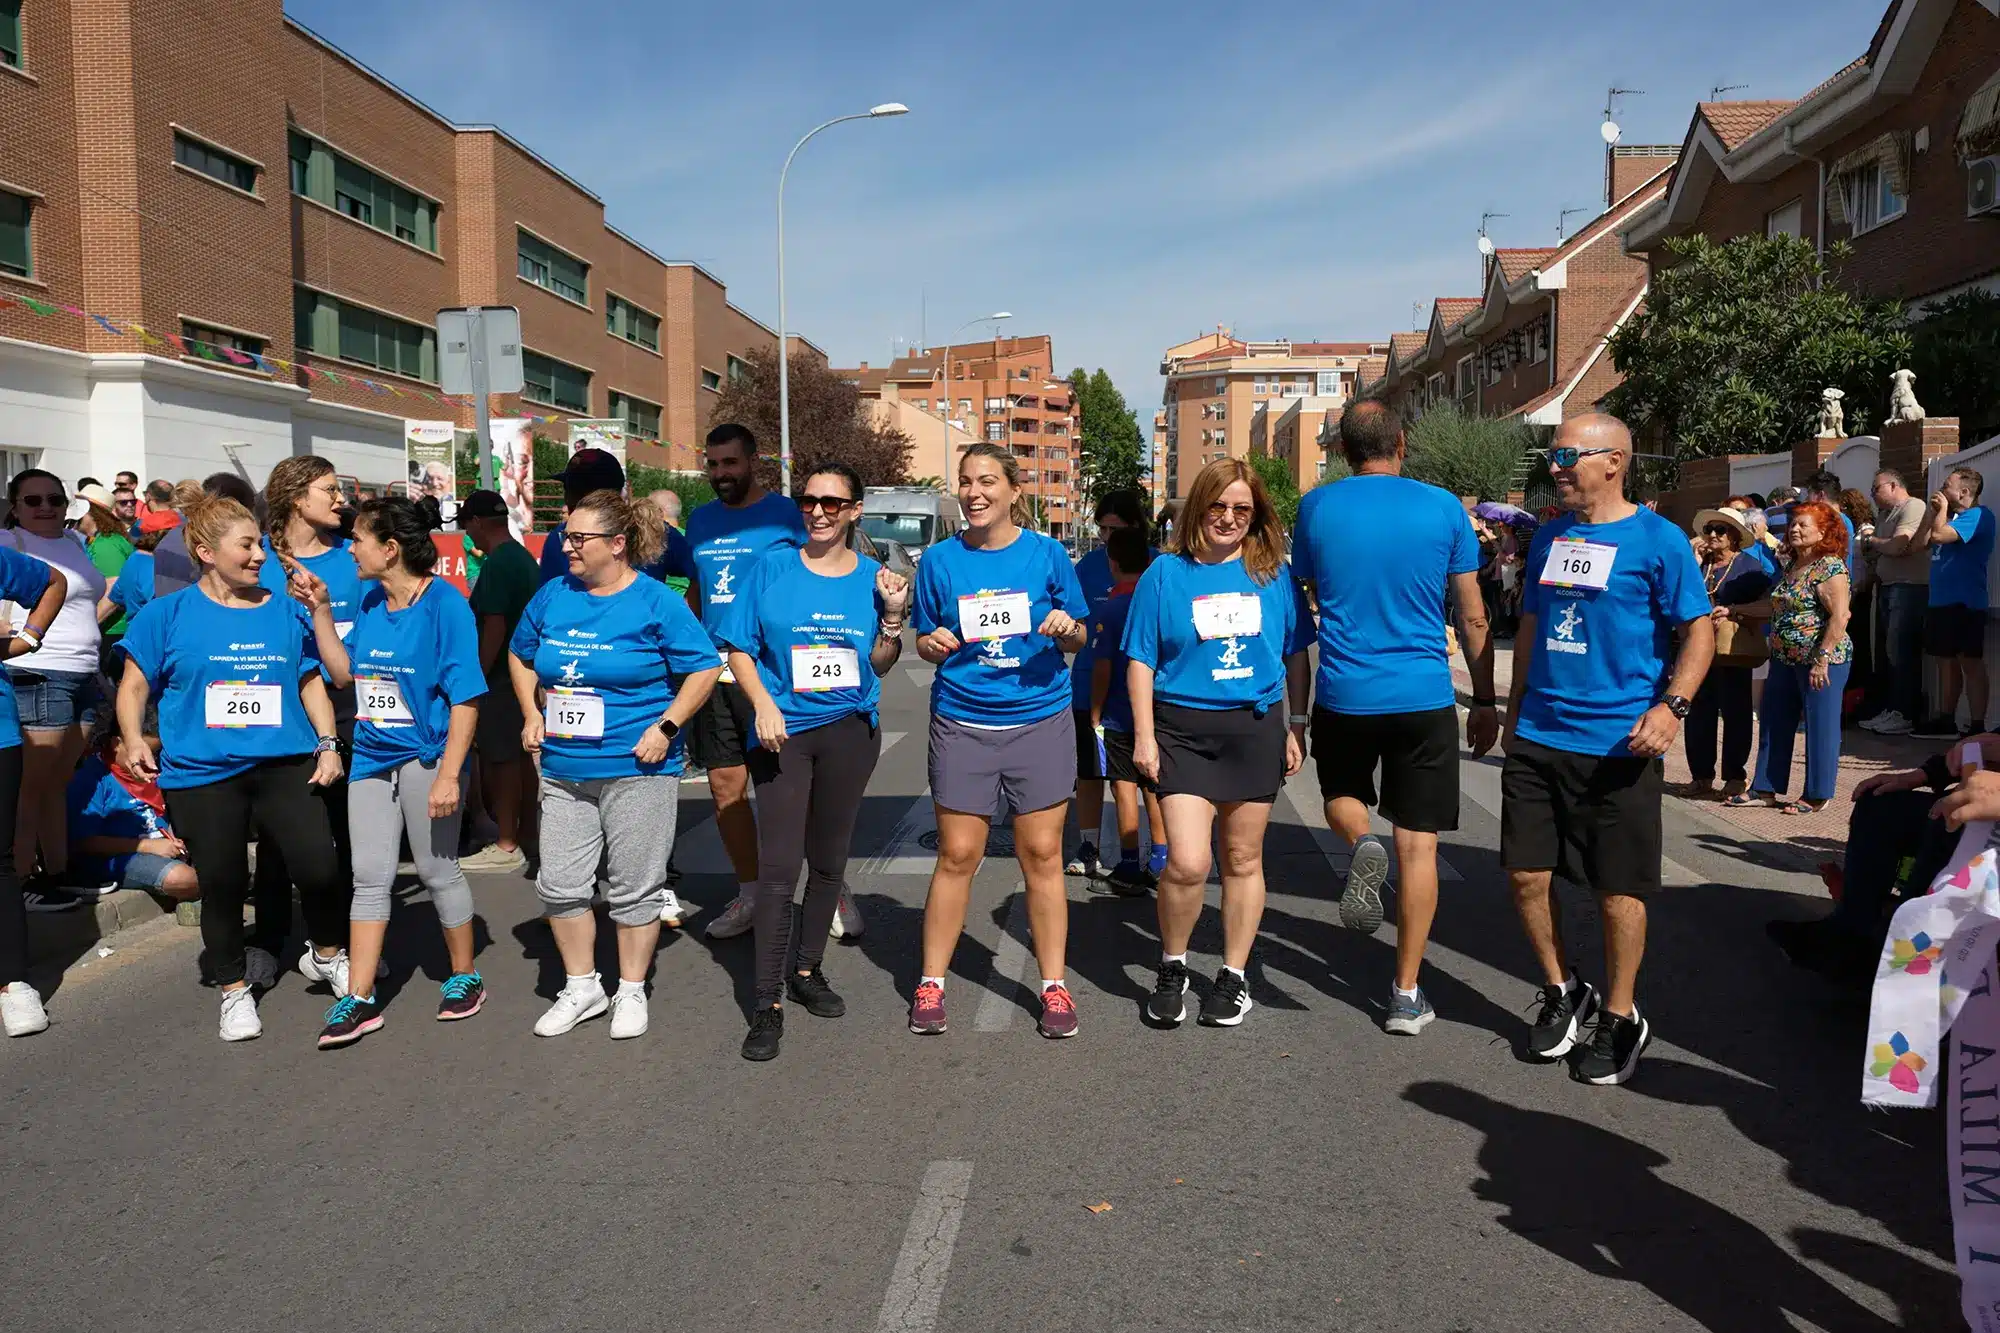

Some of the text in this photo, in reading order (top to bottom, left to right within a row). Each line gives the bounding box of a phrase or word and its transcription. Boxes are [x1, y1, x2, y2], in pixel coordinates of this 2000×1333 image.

[1563, 558, 1591, 574] 160
[1556, 589, 1585, 598] ALCORCÓN
[979, 611, 1011, 627] 248
[559, 649, 589, 657] ALCORCÓN
[812, 664, 841, 677] 243
[227, 701, 261, 714] 260
[368, 696, 396, 708] 259
[559, 711, 585, 724] 157
